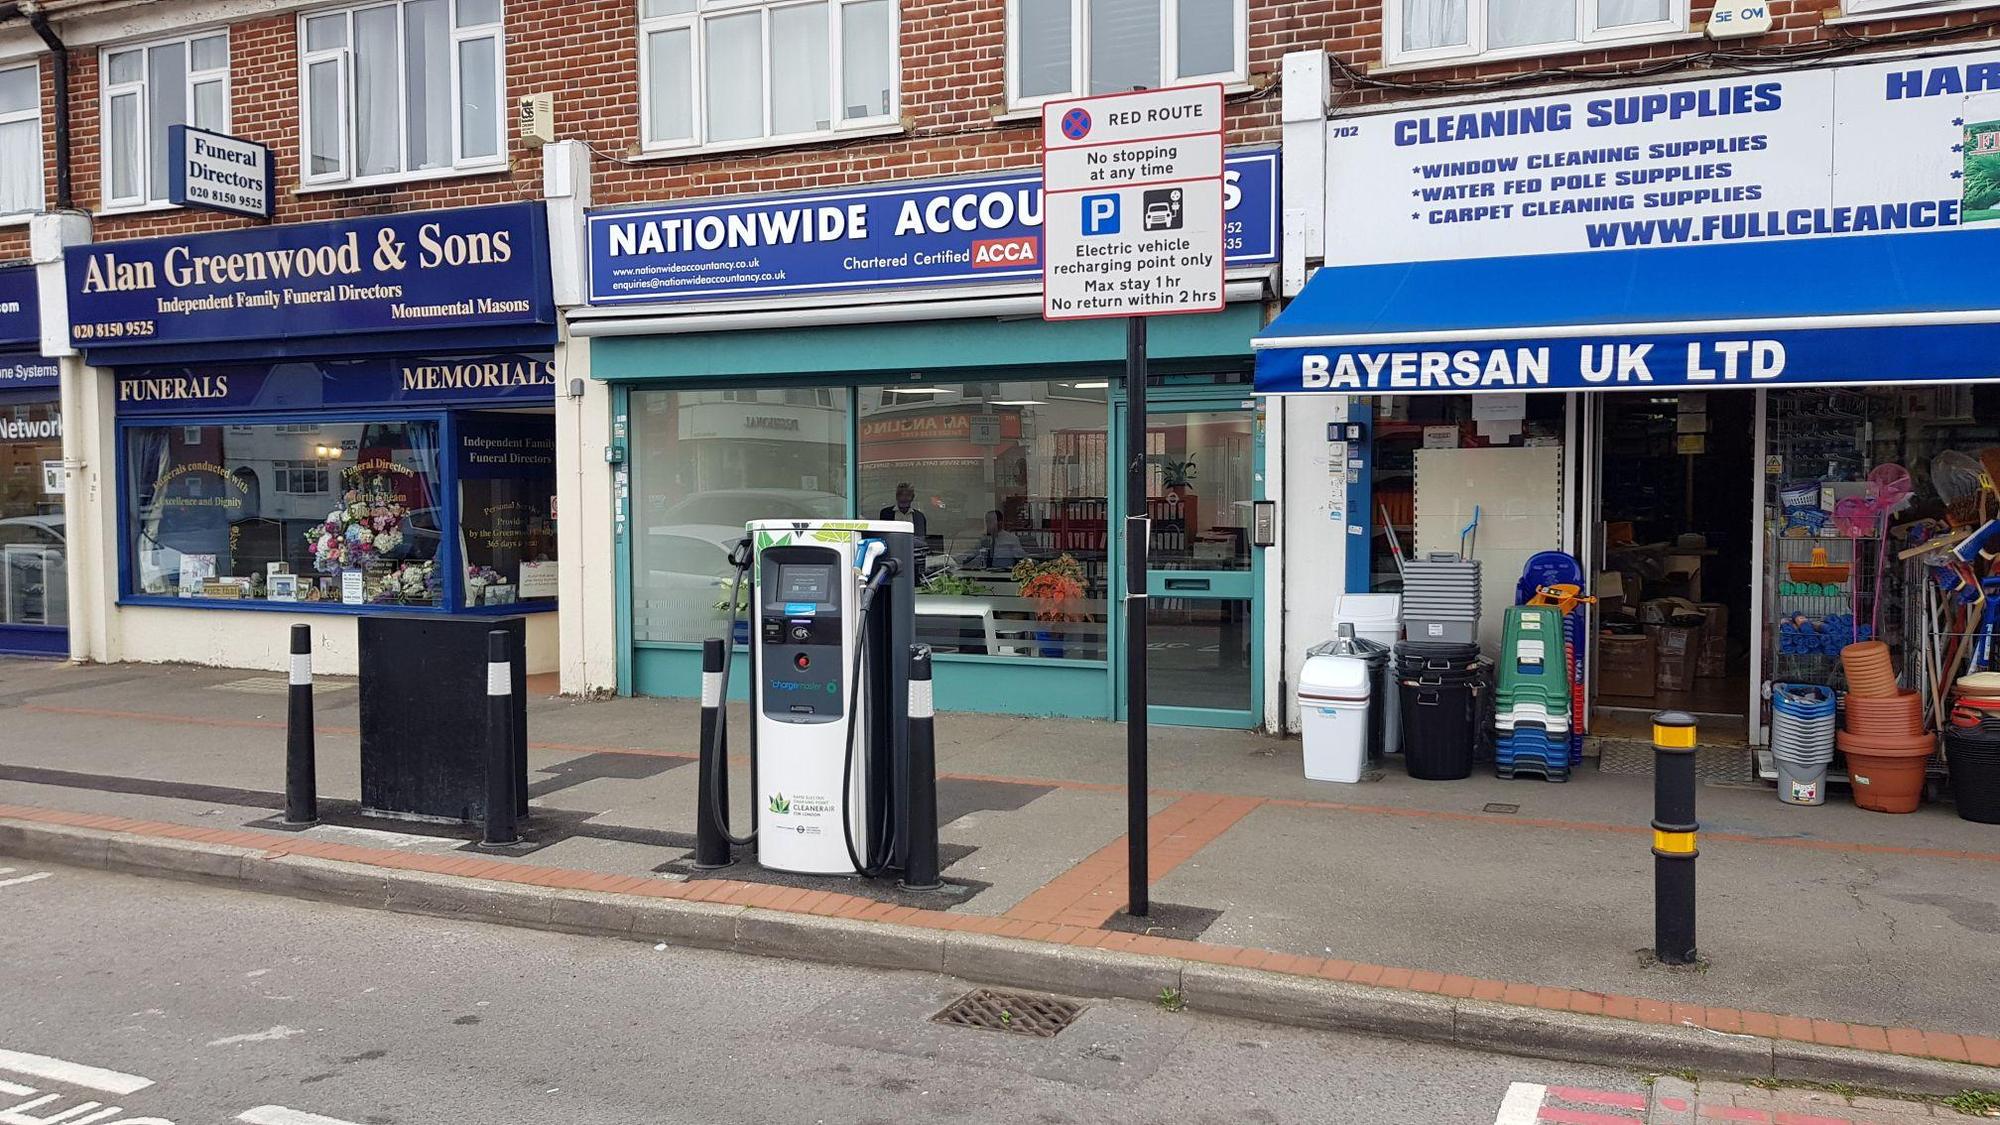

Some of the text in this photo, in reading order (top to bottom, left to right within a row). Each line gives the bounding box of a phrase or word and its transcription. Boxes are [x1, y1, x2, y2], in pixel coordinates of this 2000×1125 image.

[1109, 104, 1203, 126] RED ROUTE
[1394, 82, 1781, 147] CLEANING SUPPLIES
[1333, 126, 1359, 139] 702
[193, 137, 257, 168] Funeral
[1087, 147, 1177, 165] No stopping
[1527, 145, 1639, 170] CLEANING
[1648, 134, 1768, 160] SUPPLIES
[189, 160, 263, 192] Directors
[1090, 164, 1174, 181] at any time
[1503, 175, 1541, 196] FED
[1550, 171, 1607, 192] POLE
[1615, 163, 1732, 188] SUPPLIES
[190, 186, 263, 209] 020 8150 9525
[1428, 184, 1762, 225] CARPET CLEANING SUPPLIES
[1091, 199, 1115, 232] P
[608, 204, 868, 257] NATIONWIDE
[82, 222, 512, 294] Alan Greenwood & Sons
[843, 243, 1034, 271] Chartered Certified ACCA
[1076, 238, 1190, 258] Electric vehicle
[613, 257, 760, 277] www.nationwideaccountancy.co.uk
[1054, 252, 1213, 275] recharging point only
[612, 270, 786, 291] enquiries@nationwideaccountancy.co.uk
[1084, 279, 1115, 292] Max
[1120, 278, 1151, 292] stay
[157, 282, 403, 316] Independent Family Funeral Directors
[390, 298, 530, 320] Monumental Masons
[1052, 290, 1217, 310] No return within 2 hrs
[73, 320, 154, 339] 020 8150 9525
[15, 364, 58, 381] Systems
[1302, 338, 1786, 389] BAYERSAN UK LTD
[402, 360, 557, 391] MEMORIALS
[120, 376, 228, 401] FUNERALS
[464, 436, 523, 449] Independent
[341, 458, 415, 479] Funeral Directors
[470, 452, 552, 464] Funeral Directors
[187, 460, 231, 480] conducted
[231, 473, 249, 495] with
[215, 496, 243, 509] Dignity
